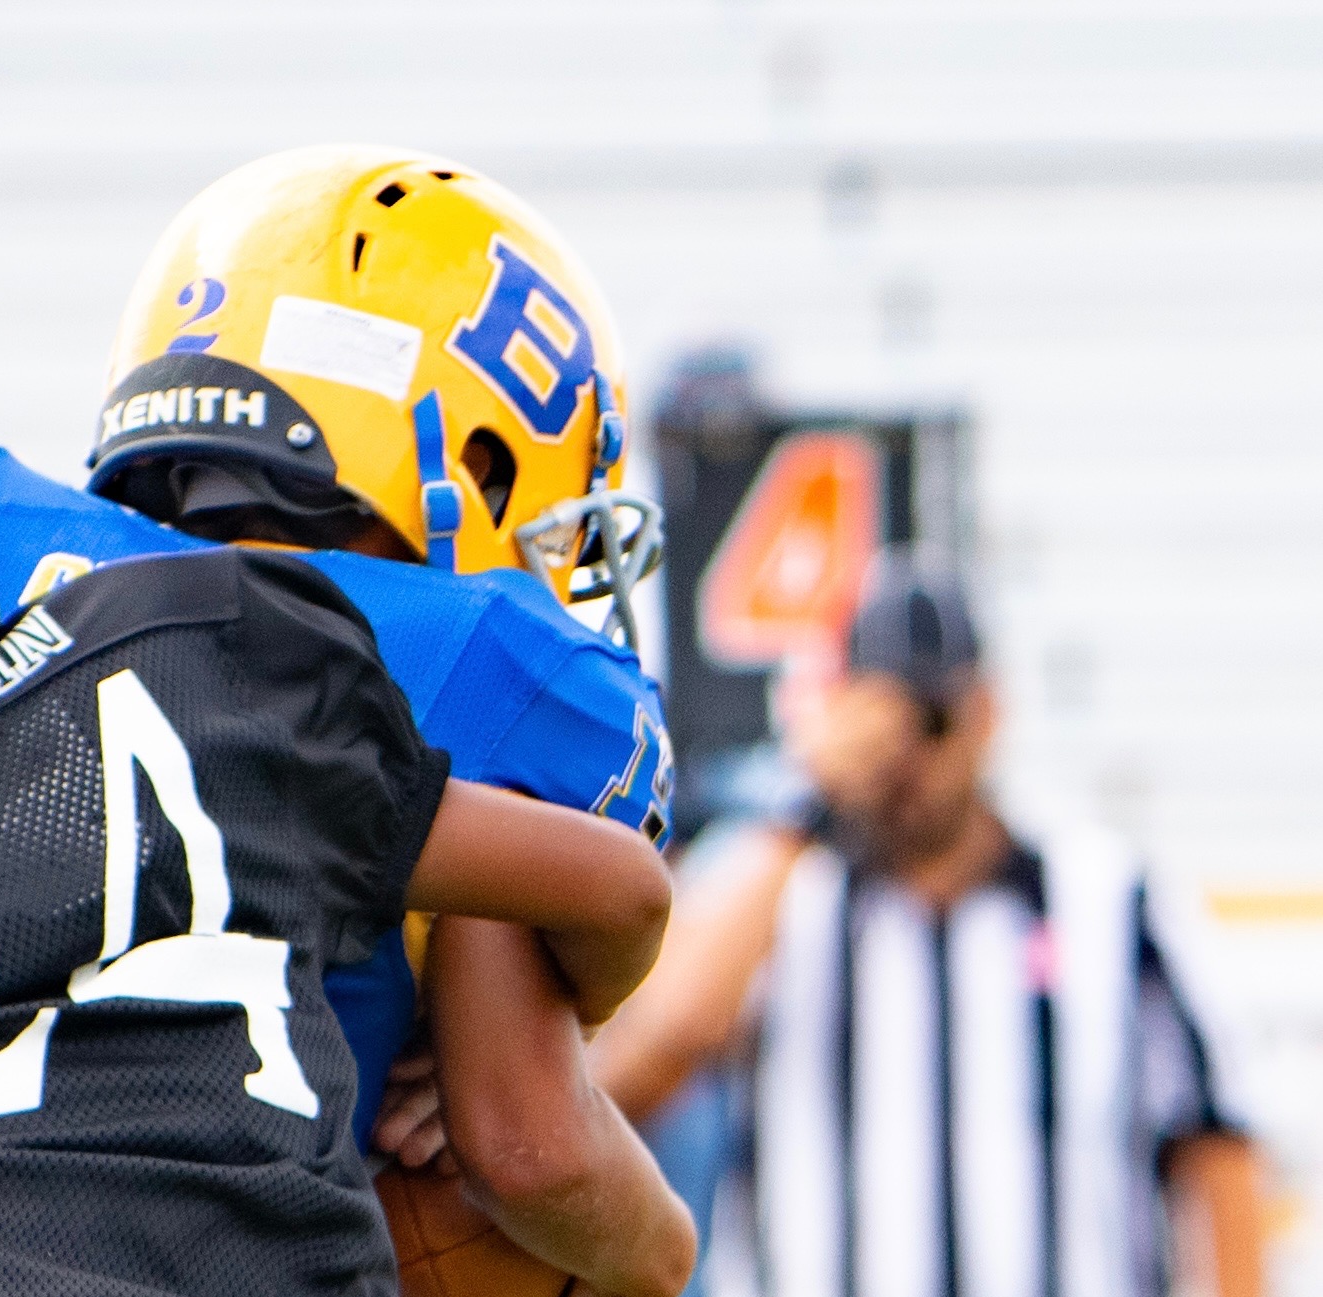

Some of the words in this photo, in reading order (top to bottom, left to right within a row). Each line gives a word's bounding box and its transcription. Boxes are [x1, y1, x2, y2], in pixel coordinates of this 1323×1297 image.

[166, 277, 226, 355] 2
[450, 233, 596, 443] B
[100, 387, 266, 443] XENITH
[696, 434, 881, 690] 4
